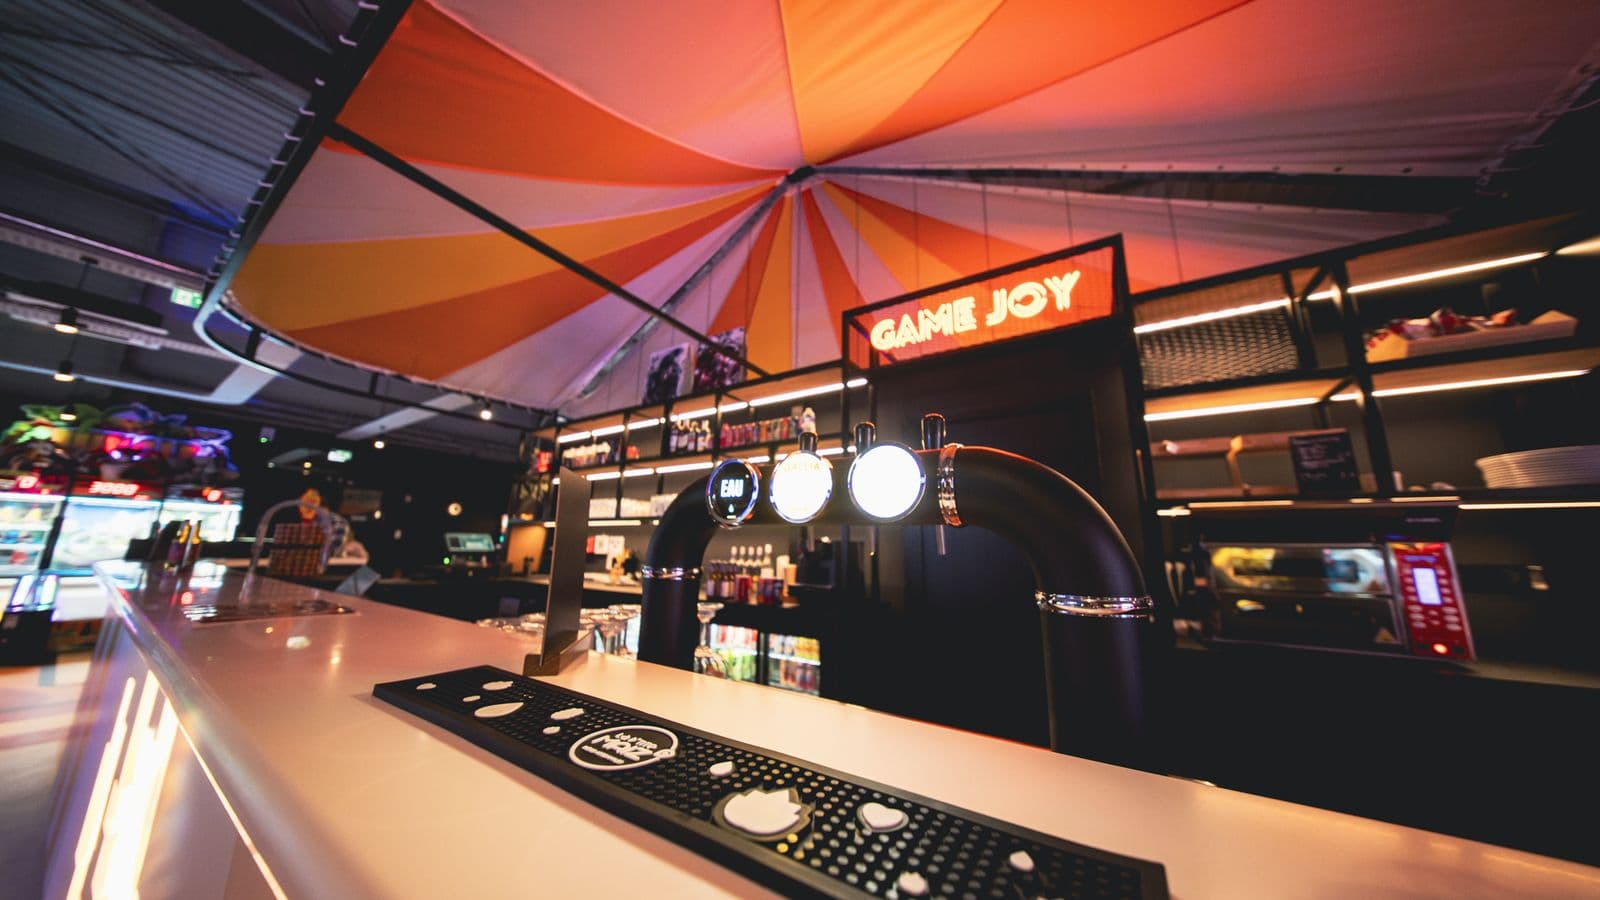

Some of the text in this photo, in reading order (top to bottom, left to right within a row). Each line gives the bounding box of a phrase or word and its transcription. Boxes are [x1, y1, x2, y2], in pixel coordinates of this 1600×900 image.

[870, 270, 1081, 350] GAME JOY
[720, 478, 744, 498] EAU
